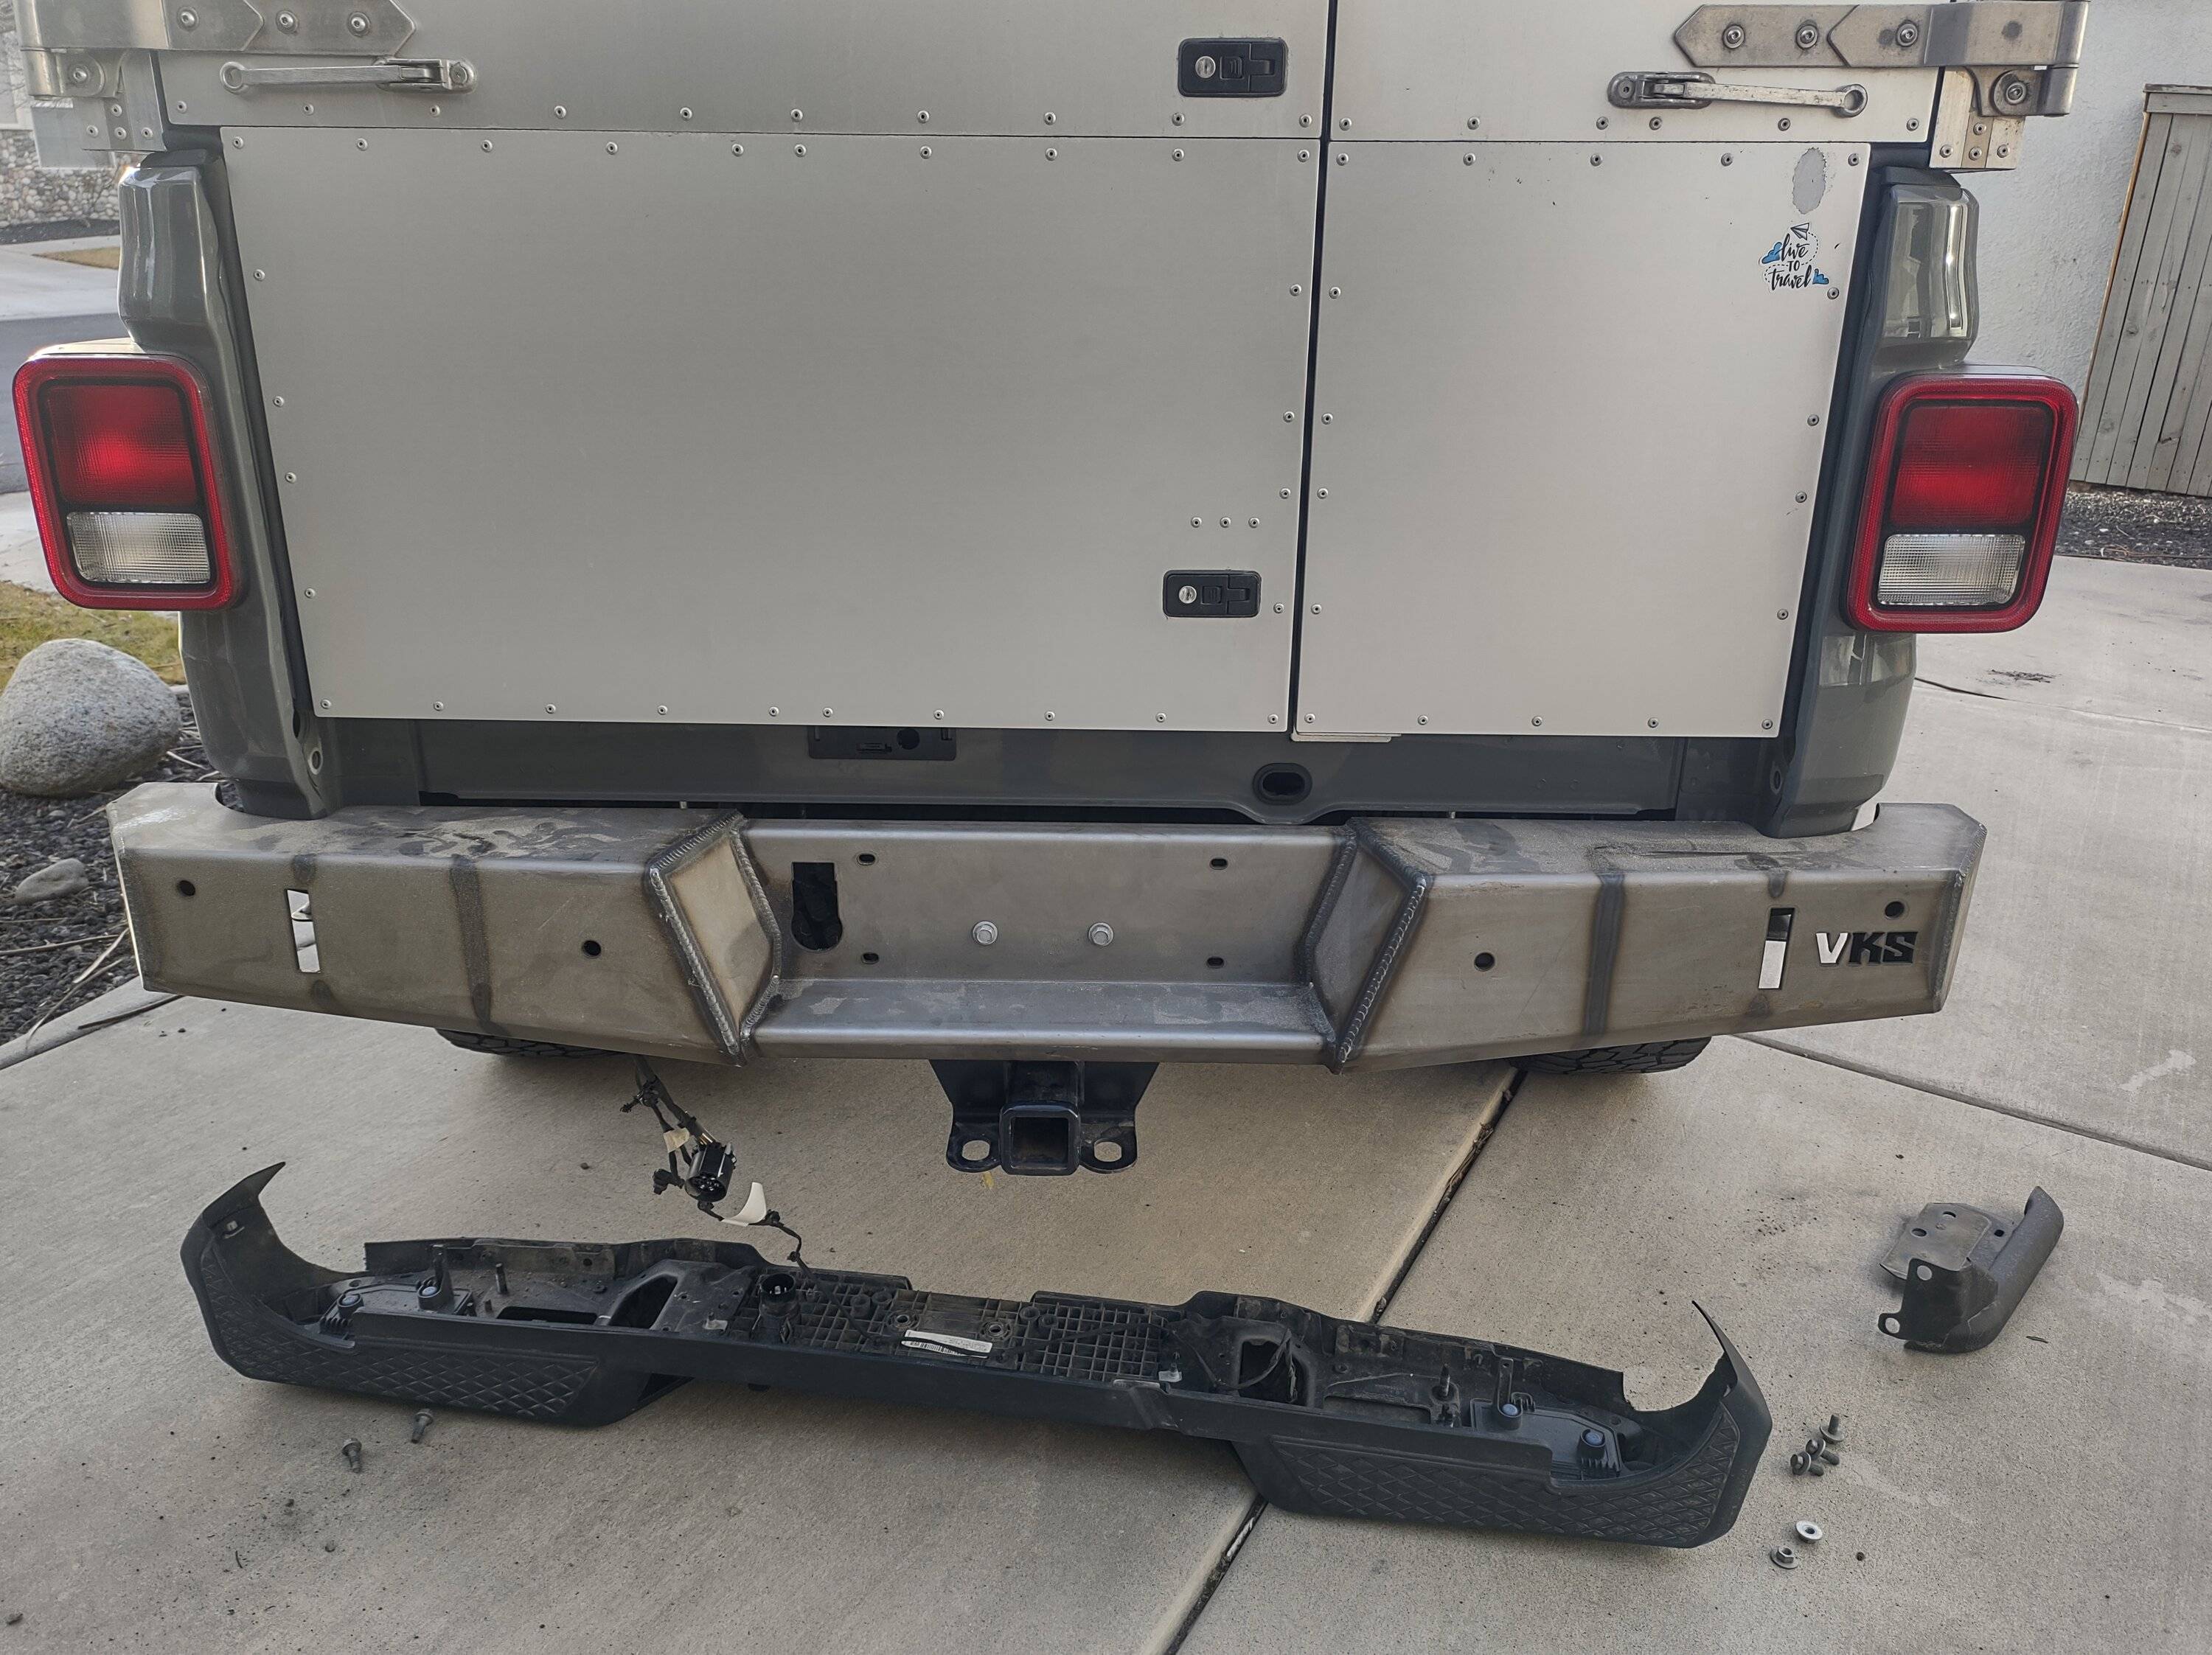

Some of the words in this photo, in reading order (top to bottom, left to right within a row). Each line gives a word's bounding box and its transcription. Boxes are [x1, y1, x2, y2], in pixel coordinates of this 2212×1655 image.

[1777, 233, 1810, 262] live
[1767, 264, 1812, 290] travel
[1816, 932, 1918, 964] VKS
